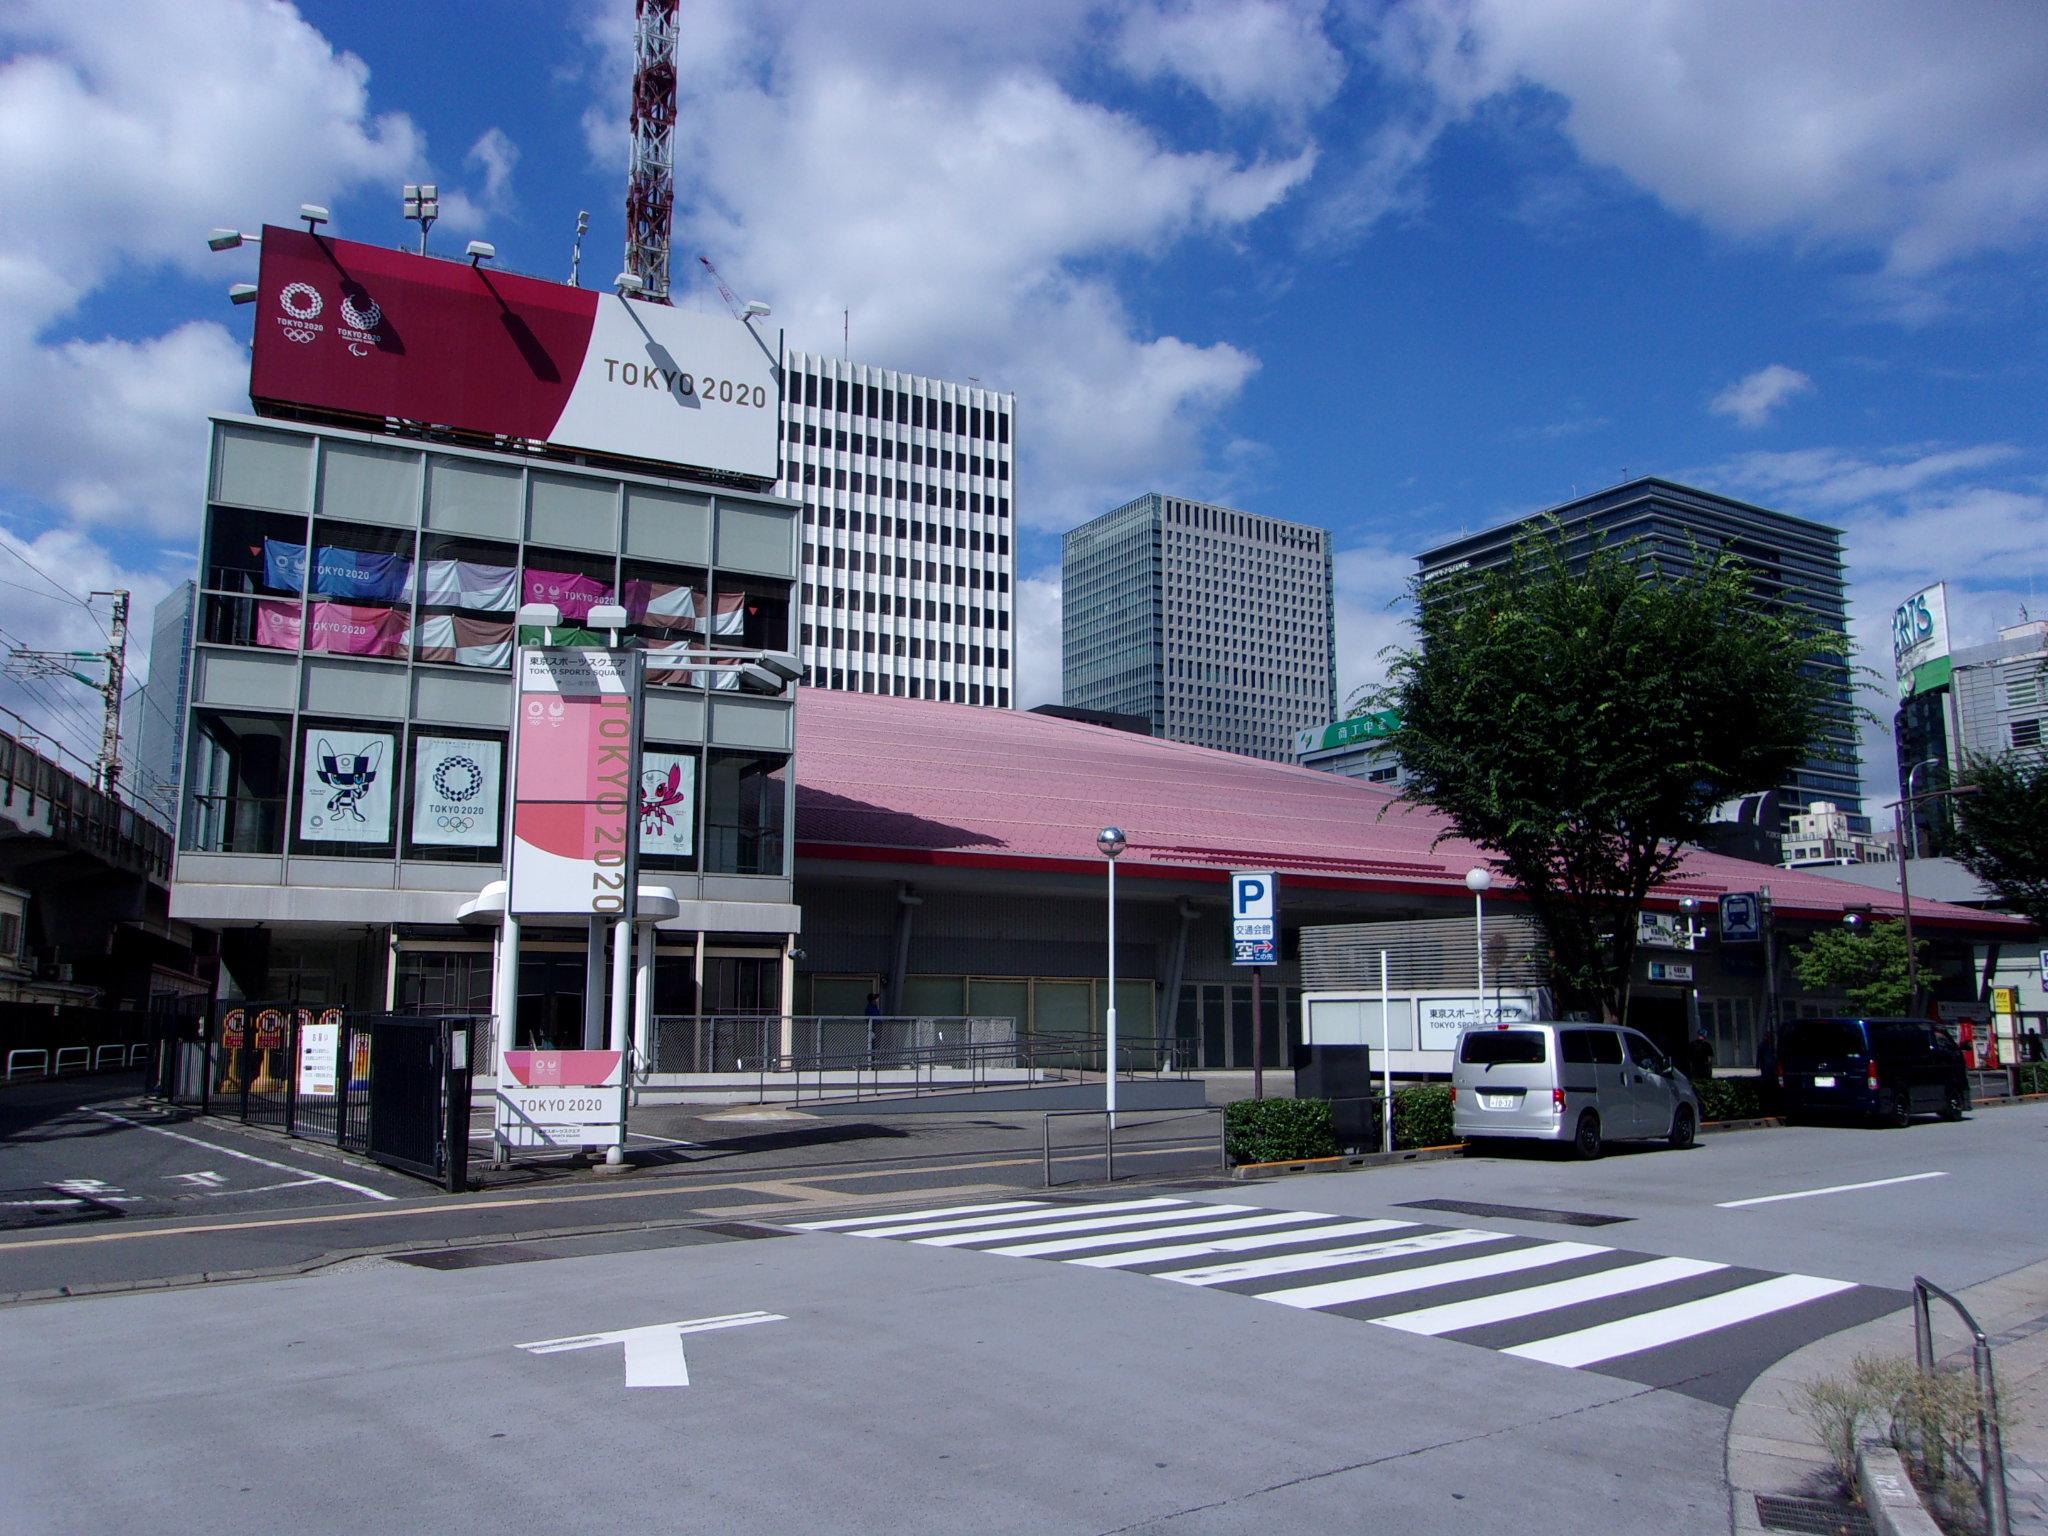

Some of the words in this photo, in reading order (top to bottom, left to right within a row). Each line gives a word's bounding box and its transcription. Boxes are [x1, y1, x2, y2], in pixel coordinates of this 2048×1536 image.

[277, 317, 303, 328] TOKYO
[304, 322, 324, 332] 2020
[338, 328, 361, 338] TOKYO
[362, 332, 381, 342] 2020
[604, 358, 694, 396] TOKYO
[702, 377, 766, 409] 2020
[313, 565, 344, 577] TOKYO
[345, 569, 370, 580] 2020
[564, 591, 593, 603] TOKYO
[594, 595, 615, 605] 2020
[309, 622, 340, 632] TOKYO
[341, 625, 366, 635] 2020
[529, 656, 626, 667] 東京スポーツスクエア
[559, 668, 591, 676] SPORTS
[593, 669, 626, 677] SQUARE
[596, 697, 632, 815] TOKYO
[429, 804, 460, 814] TOKYO
[461, 806, 484, 815] 2020
[592, 826, 625, 913] 2020
[1239, 880, 1264, 913] P
[1236, 924, 1271, 936] 交通会館
[1235, 941, 1254, 960] 空
[1430, 1021, 1455, 1029] TOKYO
[520, 1099, 565, 1112] TOKYO
[568, 1099, 602, 1111] 2020
